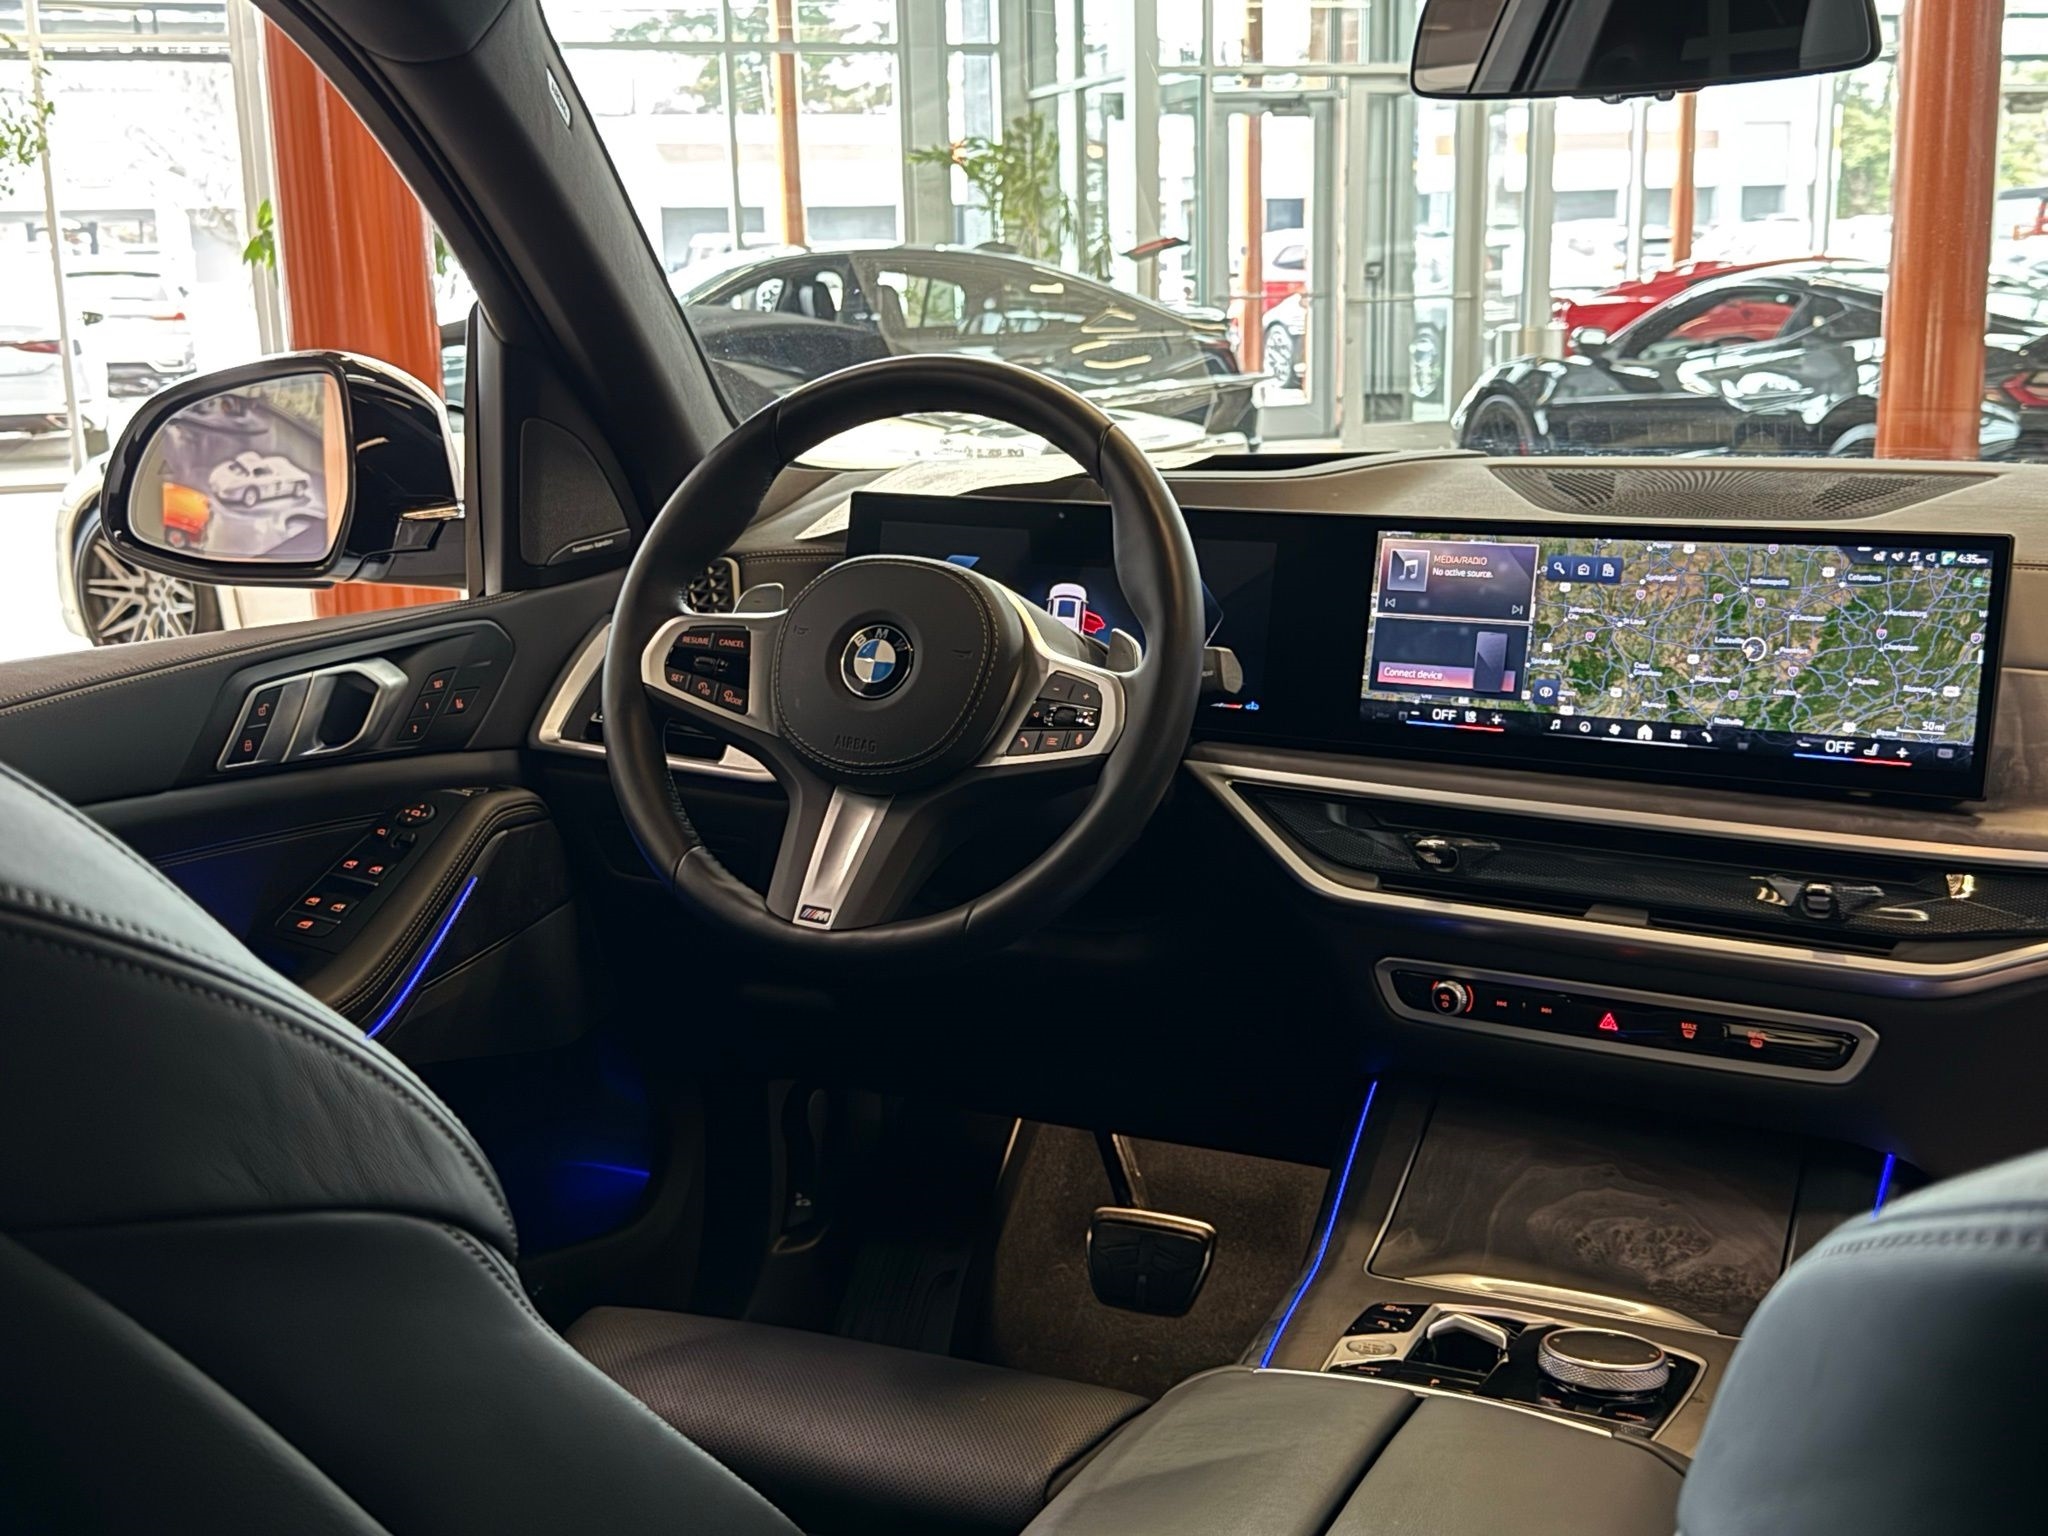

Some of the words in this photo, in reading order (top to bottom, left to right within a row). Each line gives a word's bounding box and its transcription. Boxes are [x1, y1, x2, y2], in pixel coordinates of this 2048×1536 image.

[1433, 555, 1488, 566] MEDIA/RADIO
[1433, 567, 1443, 575] No
[1444, 568, 1466, 577] active
[1466, 570, 1494, 578] source.
[1848, 573, 1882, 582] Columbus
[682, 636, 709, 645] RESUME
[719, 639, 745, 648] CANCEL
[853, 628, 908, 652] BMW
[671, 673, 684, 682] SET
[1383, 666, 1416, 678] Connect
[1417, 670, 1443, 680] device
[1432, 708, 1457, 721] OFF
[1922, 721, 1935, 731] 50
[833, 735, 877, 752] AIRBAG
[1825, 740, 1855, 754] OFF
[1681, 1022, 1698, 1031] MAX
